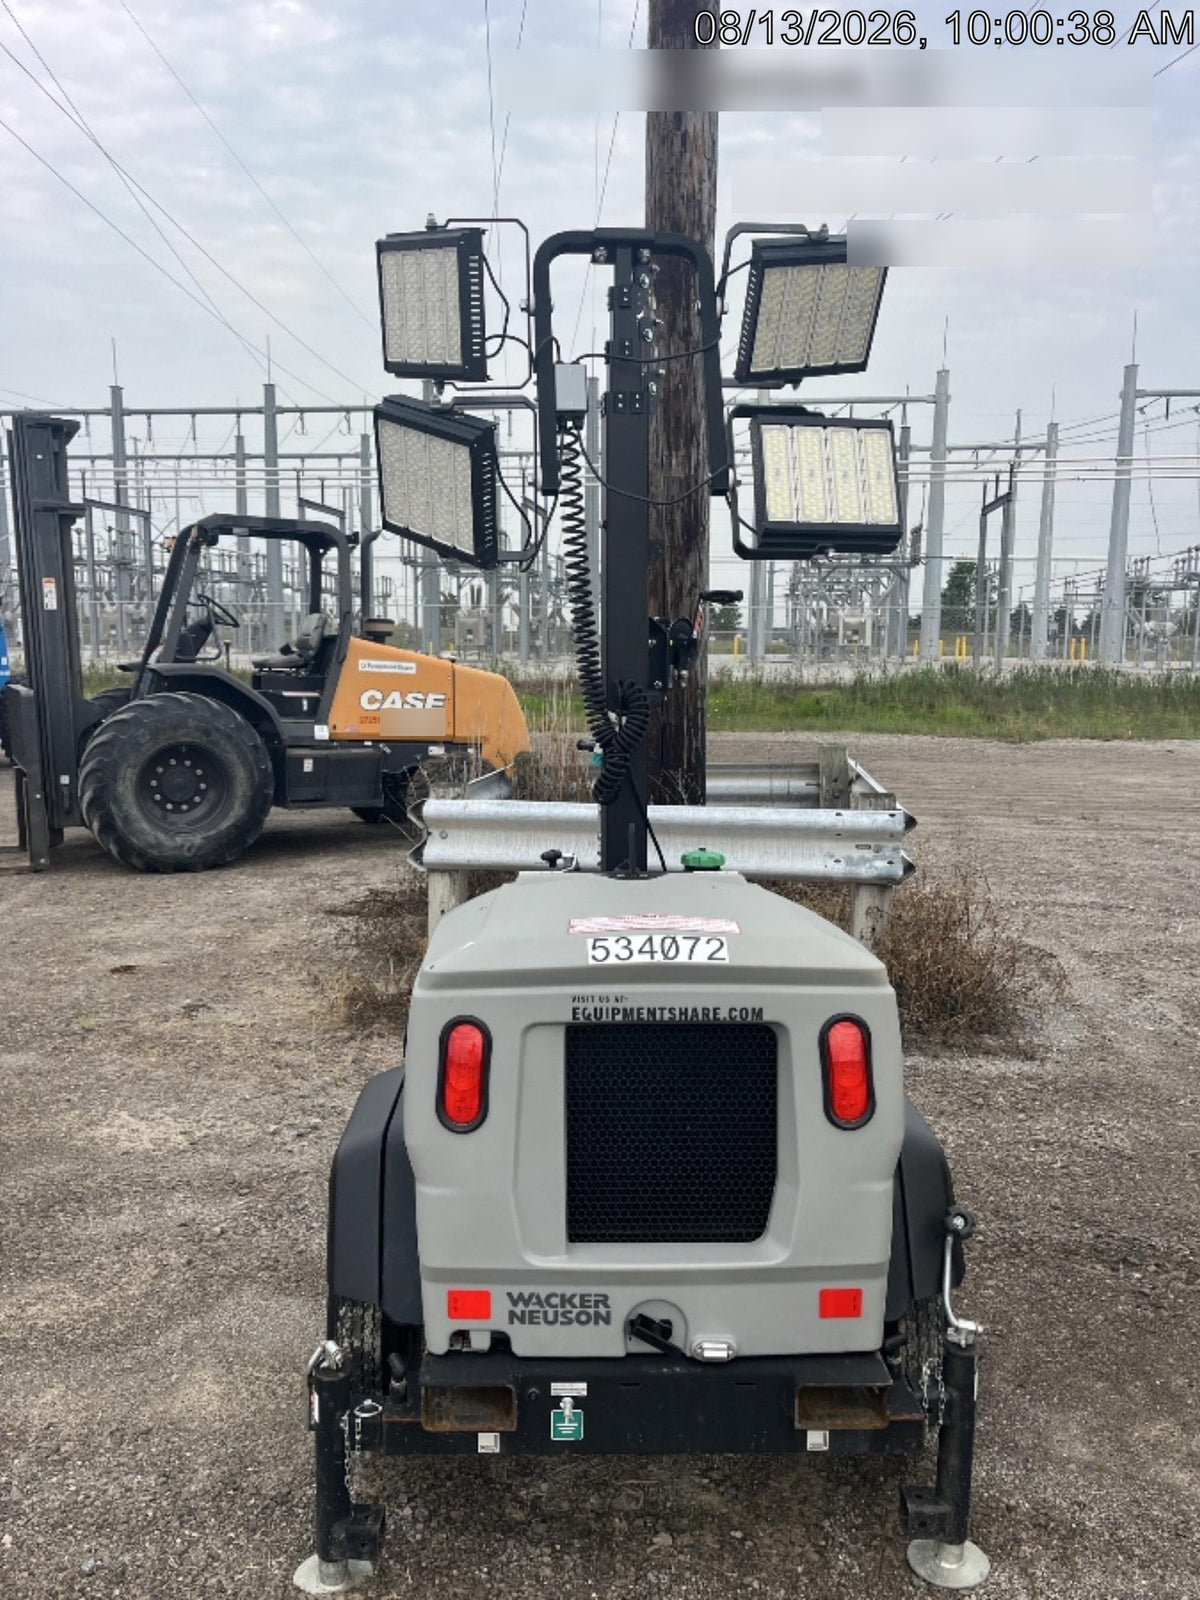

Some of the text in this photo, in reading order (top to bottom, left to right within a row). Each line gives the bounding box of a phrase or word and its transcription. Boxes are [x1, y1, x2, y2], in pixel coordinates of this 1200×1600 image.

[359, 688, 447, 711] CASE
[590, 936, 727, 963] 534072
[571, 995, 595, 1004] VISIT
[598, 995, 611, 1004] US
[571, 1006, 764, 1022] EQUIPMENTSHARE.COM
[506, 1291, 611, 1309] WACKER
[507, 1309, 612, 1326] NEUSON
